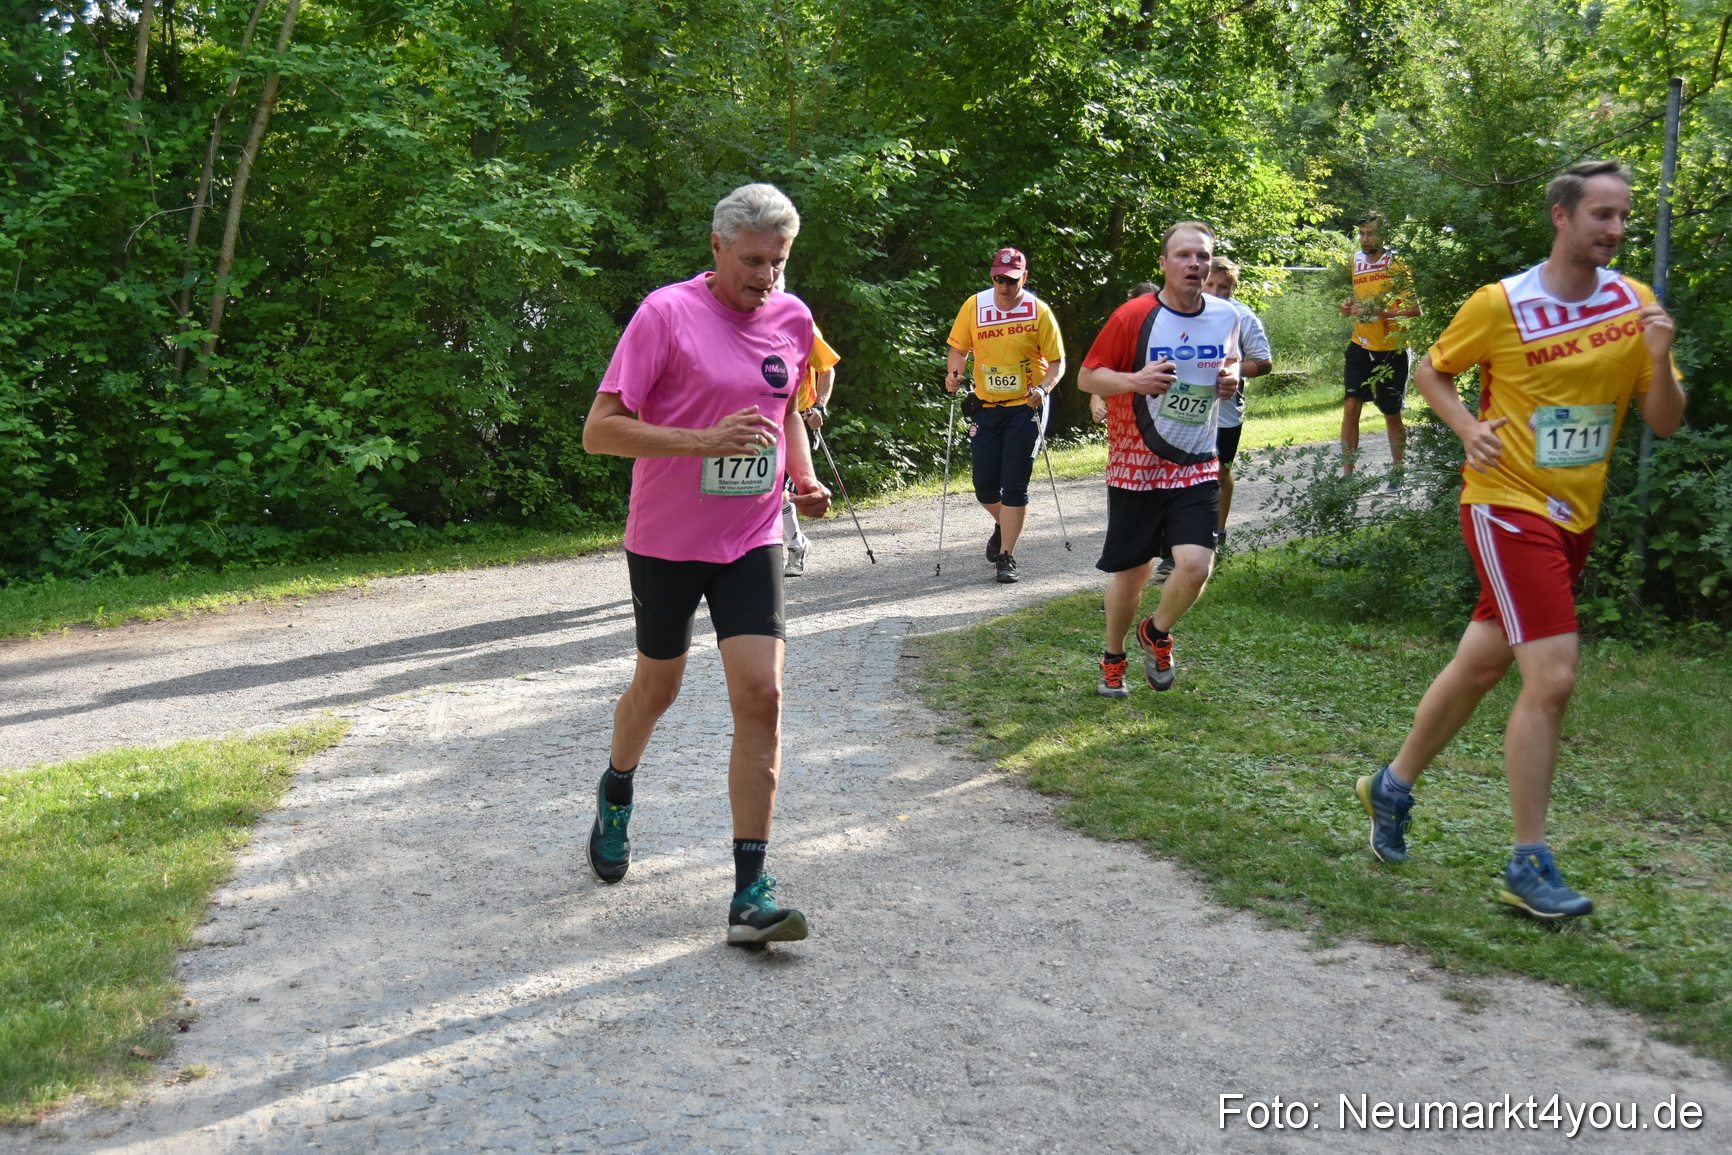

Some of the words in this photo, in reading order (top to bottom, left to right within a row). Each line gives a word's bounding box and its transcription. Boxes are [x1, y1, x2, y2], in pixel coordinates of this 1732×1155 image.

[1354, 276, 1368, 285] MAX
[977, 328, 1004, 340] MAX
[1008, 323, 1038, 335] BÖGL
[1525, 339, 1583, 367] MAX
[988, 375, 1017, 387] 1662
[1167, 394, 1208, 414] 2075
[1547, 426, 1602, 450] 1711
[714, 457, 769, 479] 1770
